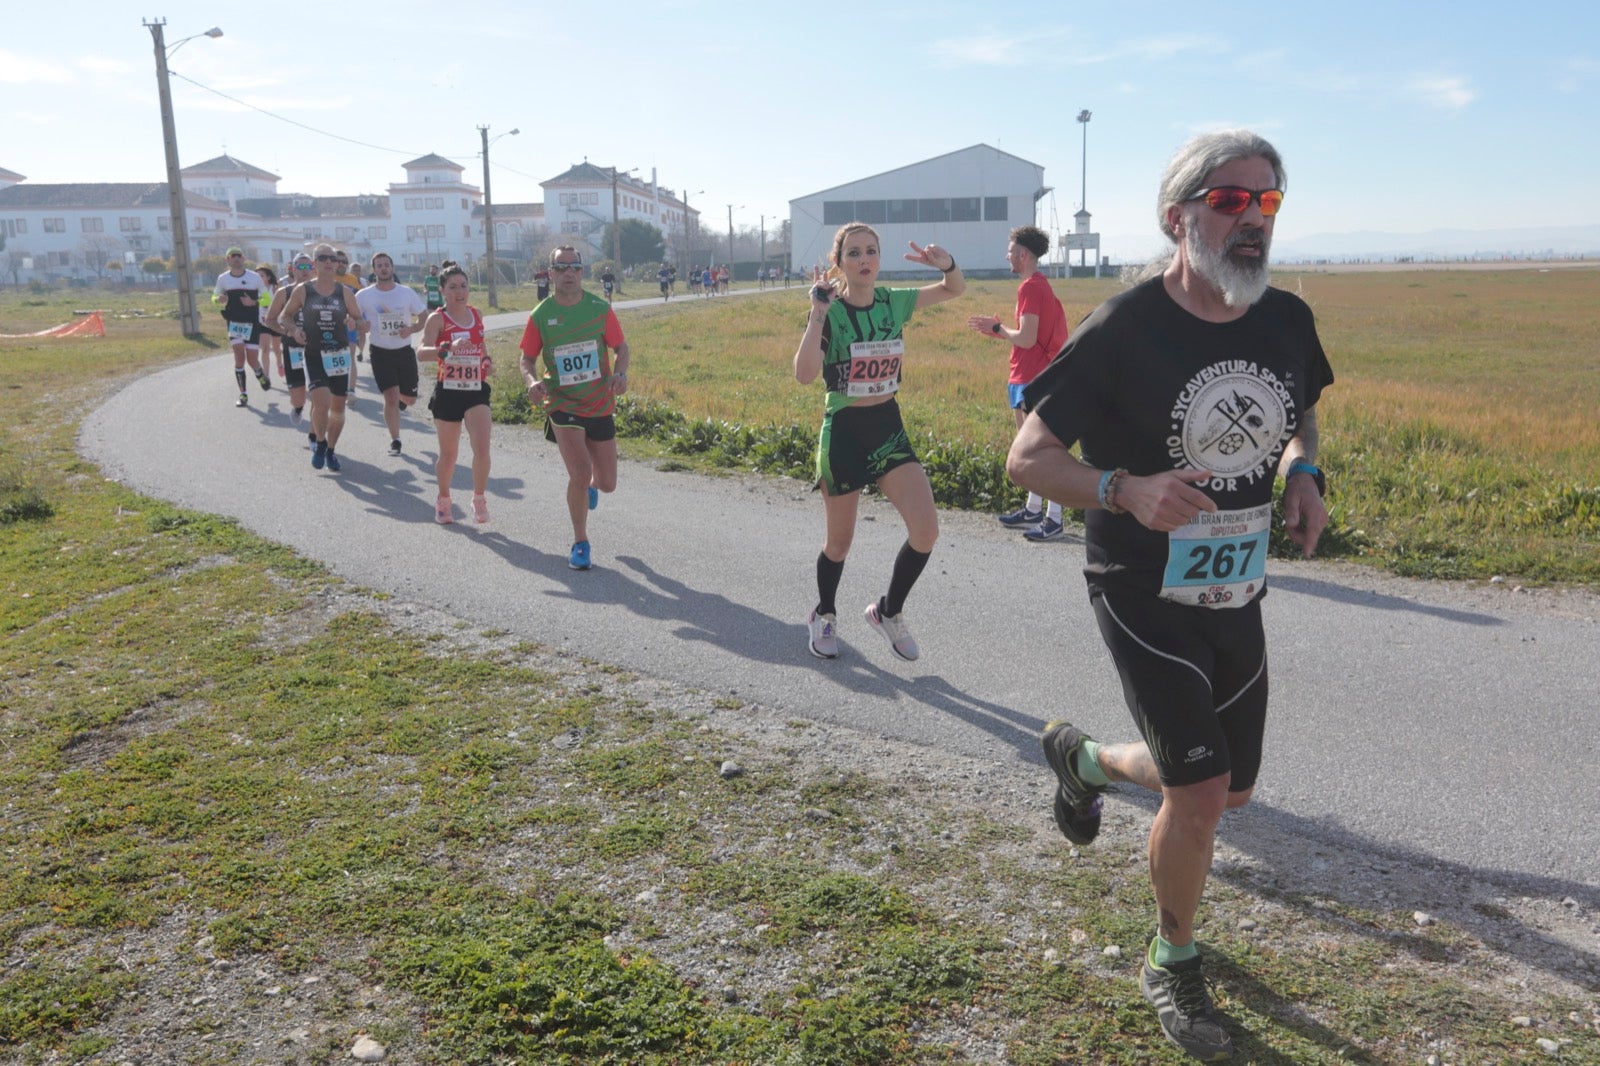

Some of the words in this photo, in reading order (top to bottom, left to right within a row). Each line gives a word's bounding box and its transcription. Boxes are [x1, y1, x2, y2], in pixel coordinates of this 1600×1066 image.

[332, 356, 346, 368] 56
[446, 366, 479, 379] 2181
[562, 353, 592, 373] 807
[853, 357, 900, 379] 2029
[1170, 359, 1259, 420] SYCAVENTURA
[1258, 367, 1295, 409] SPORT
[1243, 421, 1298, 486] TRAVEL
[1201, 513, 1222, 525] GRAN
[1222, 511, 1246, 524] PREMIO
[1246, 510, 1254, 521] DE
[1183, 539, 1258, 580] 267
